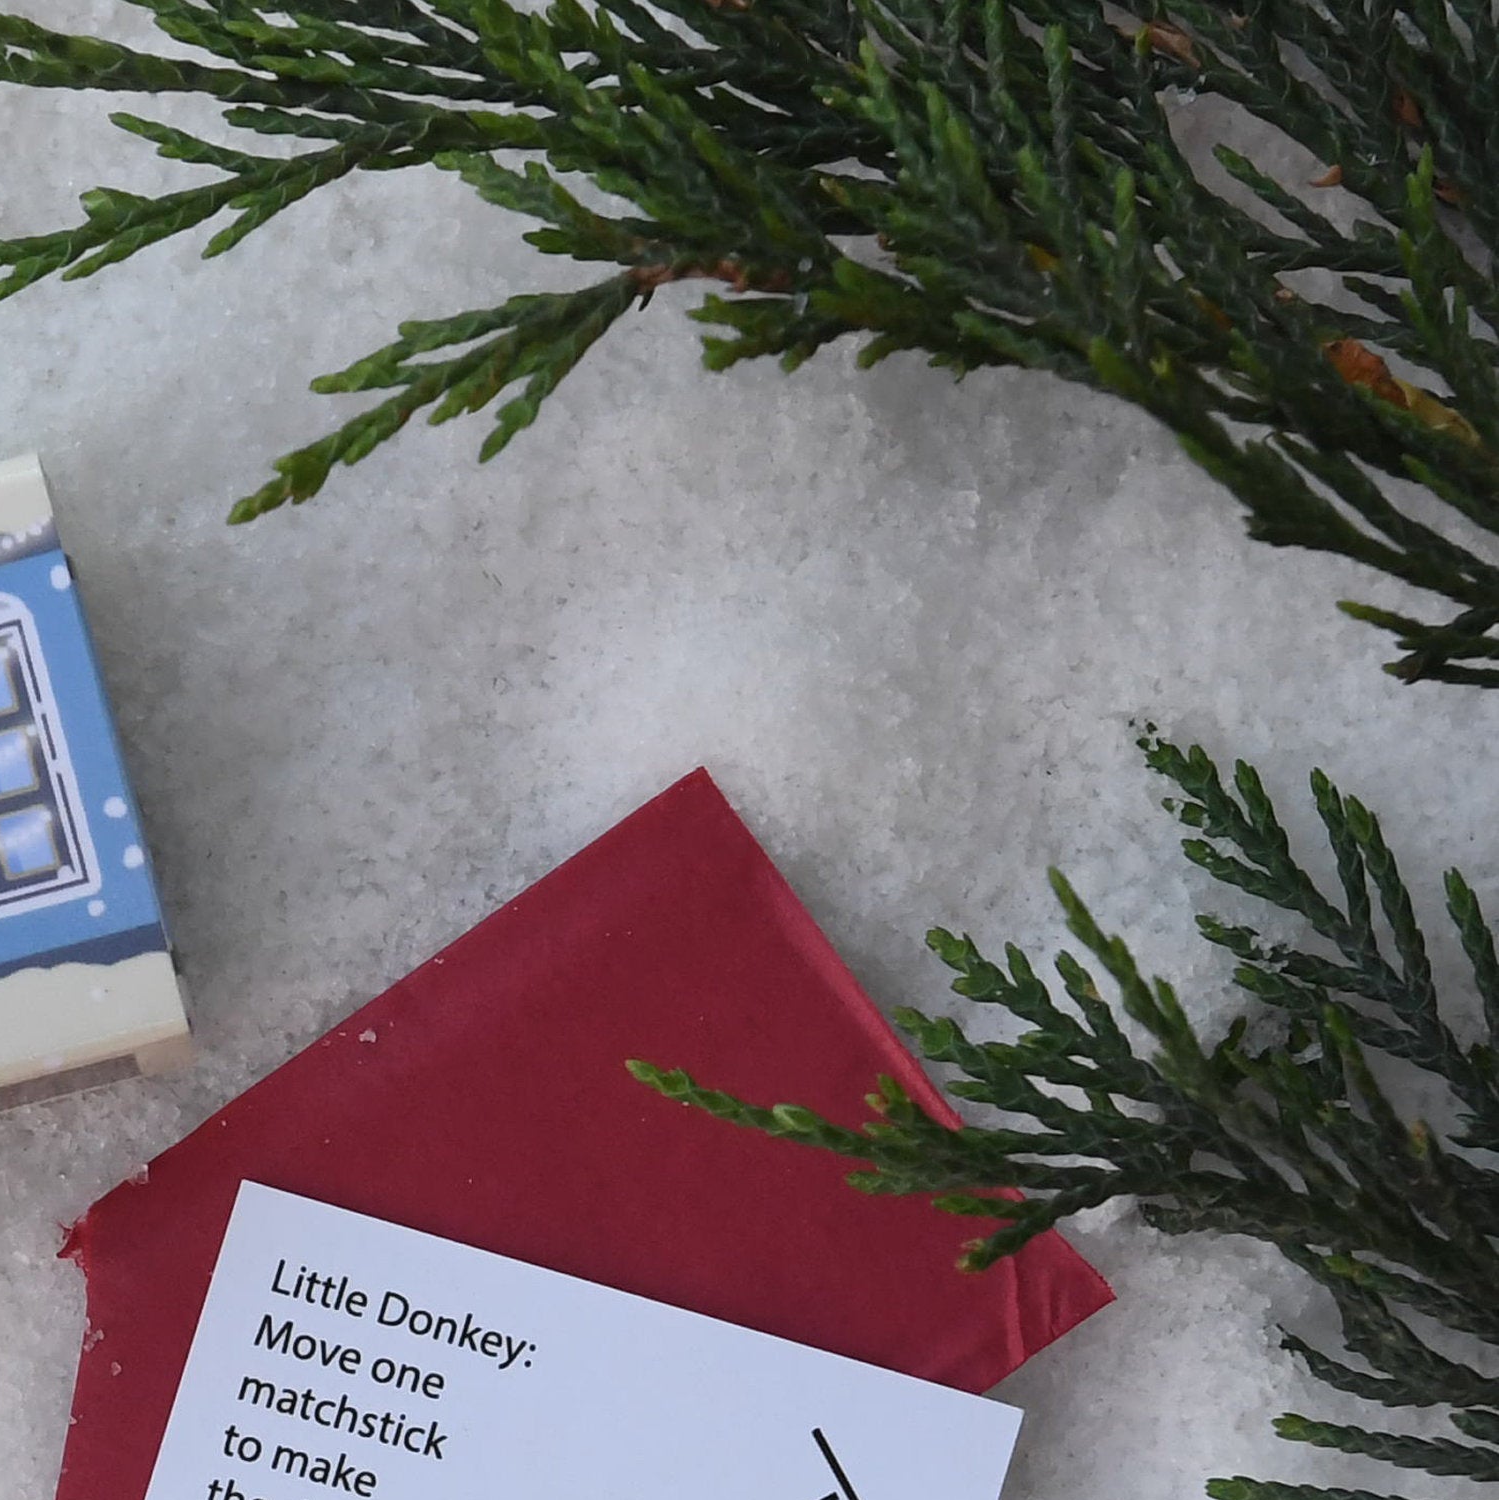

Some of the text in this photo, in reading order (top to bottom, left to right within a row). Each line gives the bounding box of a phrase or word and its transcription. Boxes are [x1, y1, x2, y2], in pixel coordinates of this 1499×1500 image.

[253, 1314, 445, 1400] Move one
[271, 1259, 537, 1370] Little Donkey:
[237, 1376, 448, 1460] matchstick
[223, 1424, 377, 1498] to make
